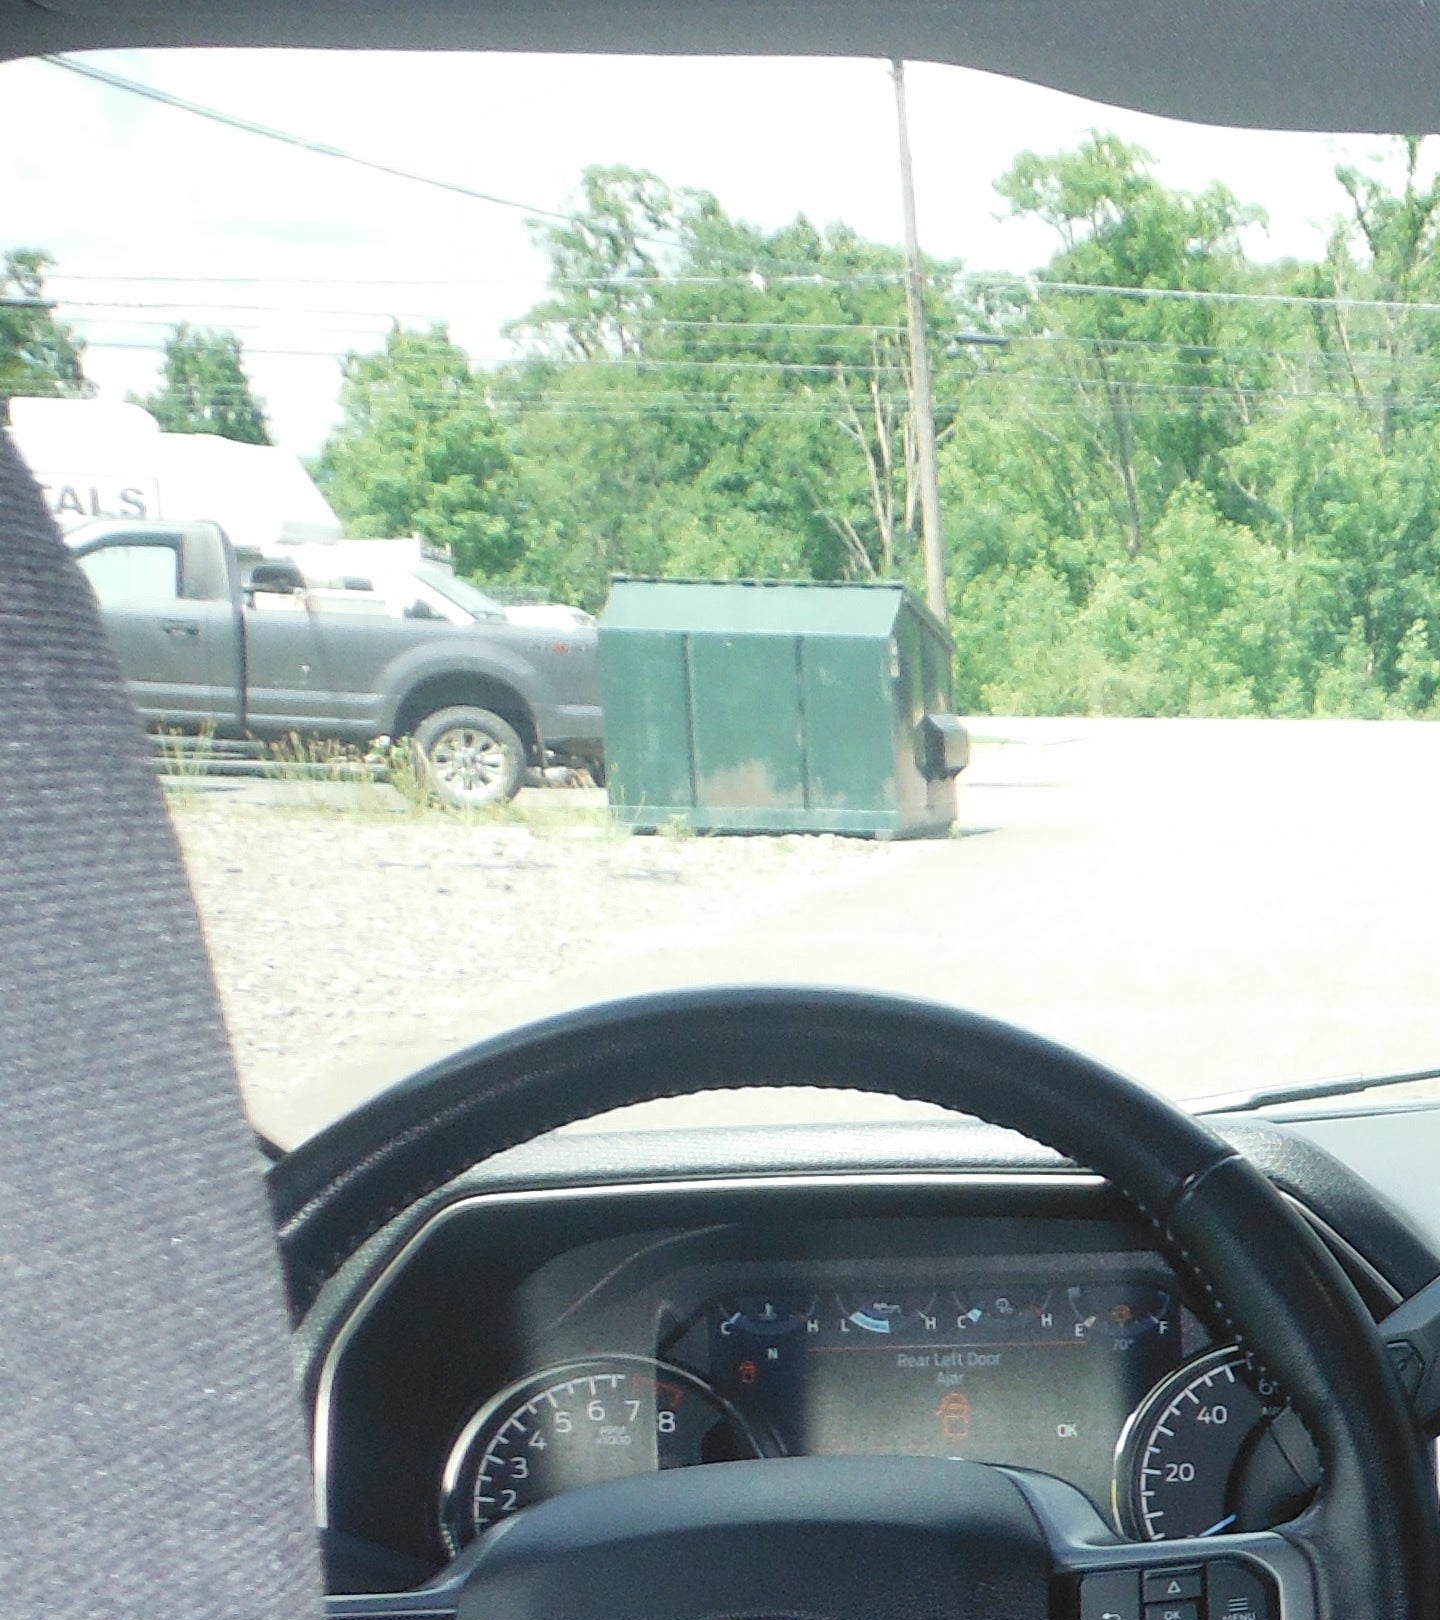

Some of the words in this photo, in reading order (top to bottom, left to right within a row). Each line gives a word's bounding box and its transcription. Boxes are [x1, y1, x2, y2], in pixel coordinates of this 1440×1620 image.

[806, 1320, 819, 1333] H
[840, 1321, 850, 1333] L
[924, 1316, 937, 1329] H
[1040, 1313, 1053, 1327] H
[1158, 1321, 1168, 1335] F
[1074, 1323, 1084, 1337] E
[767, 1348, 779, 1360] N
[897, 1353, 930, 1368] Rear
[966, 1351, 1000, 1366] Door
[586, 1401, 606, 1422] 6
[624, 1399, 641, 1422] 7
[1197, 1404, 1228, 1425] 40
[554, 1411, 573, 1434] 5
[657, 1410, 677, 1433] 8
[1056, 1423, 1078, 1439] OK
[528, 1430, 548, 1451] 4
[510, 1457, 529, 1480] 3
[1164, 1463, 1195, 1483] 20
[500, 1489, 518, 1512] 2
[1163, 1610, 1181, 1620] OK
